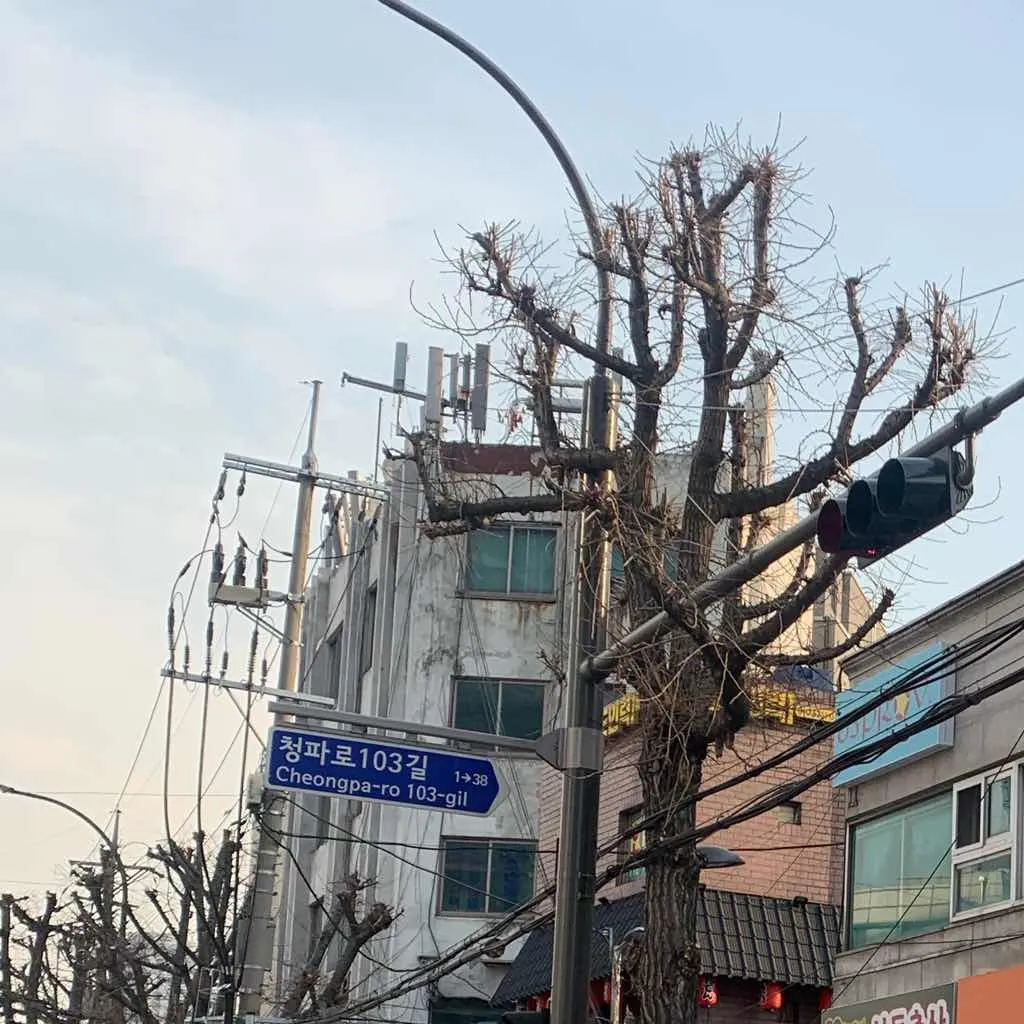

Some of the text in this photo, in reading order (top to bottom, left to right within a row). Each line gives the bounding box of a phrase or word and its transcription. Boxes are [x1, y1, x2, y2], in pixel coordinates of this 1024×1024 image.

[279, 735, 428, 781] 청파로103길
[275, 766, 468, 808] Cheongpa-ro 103-gil
